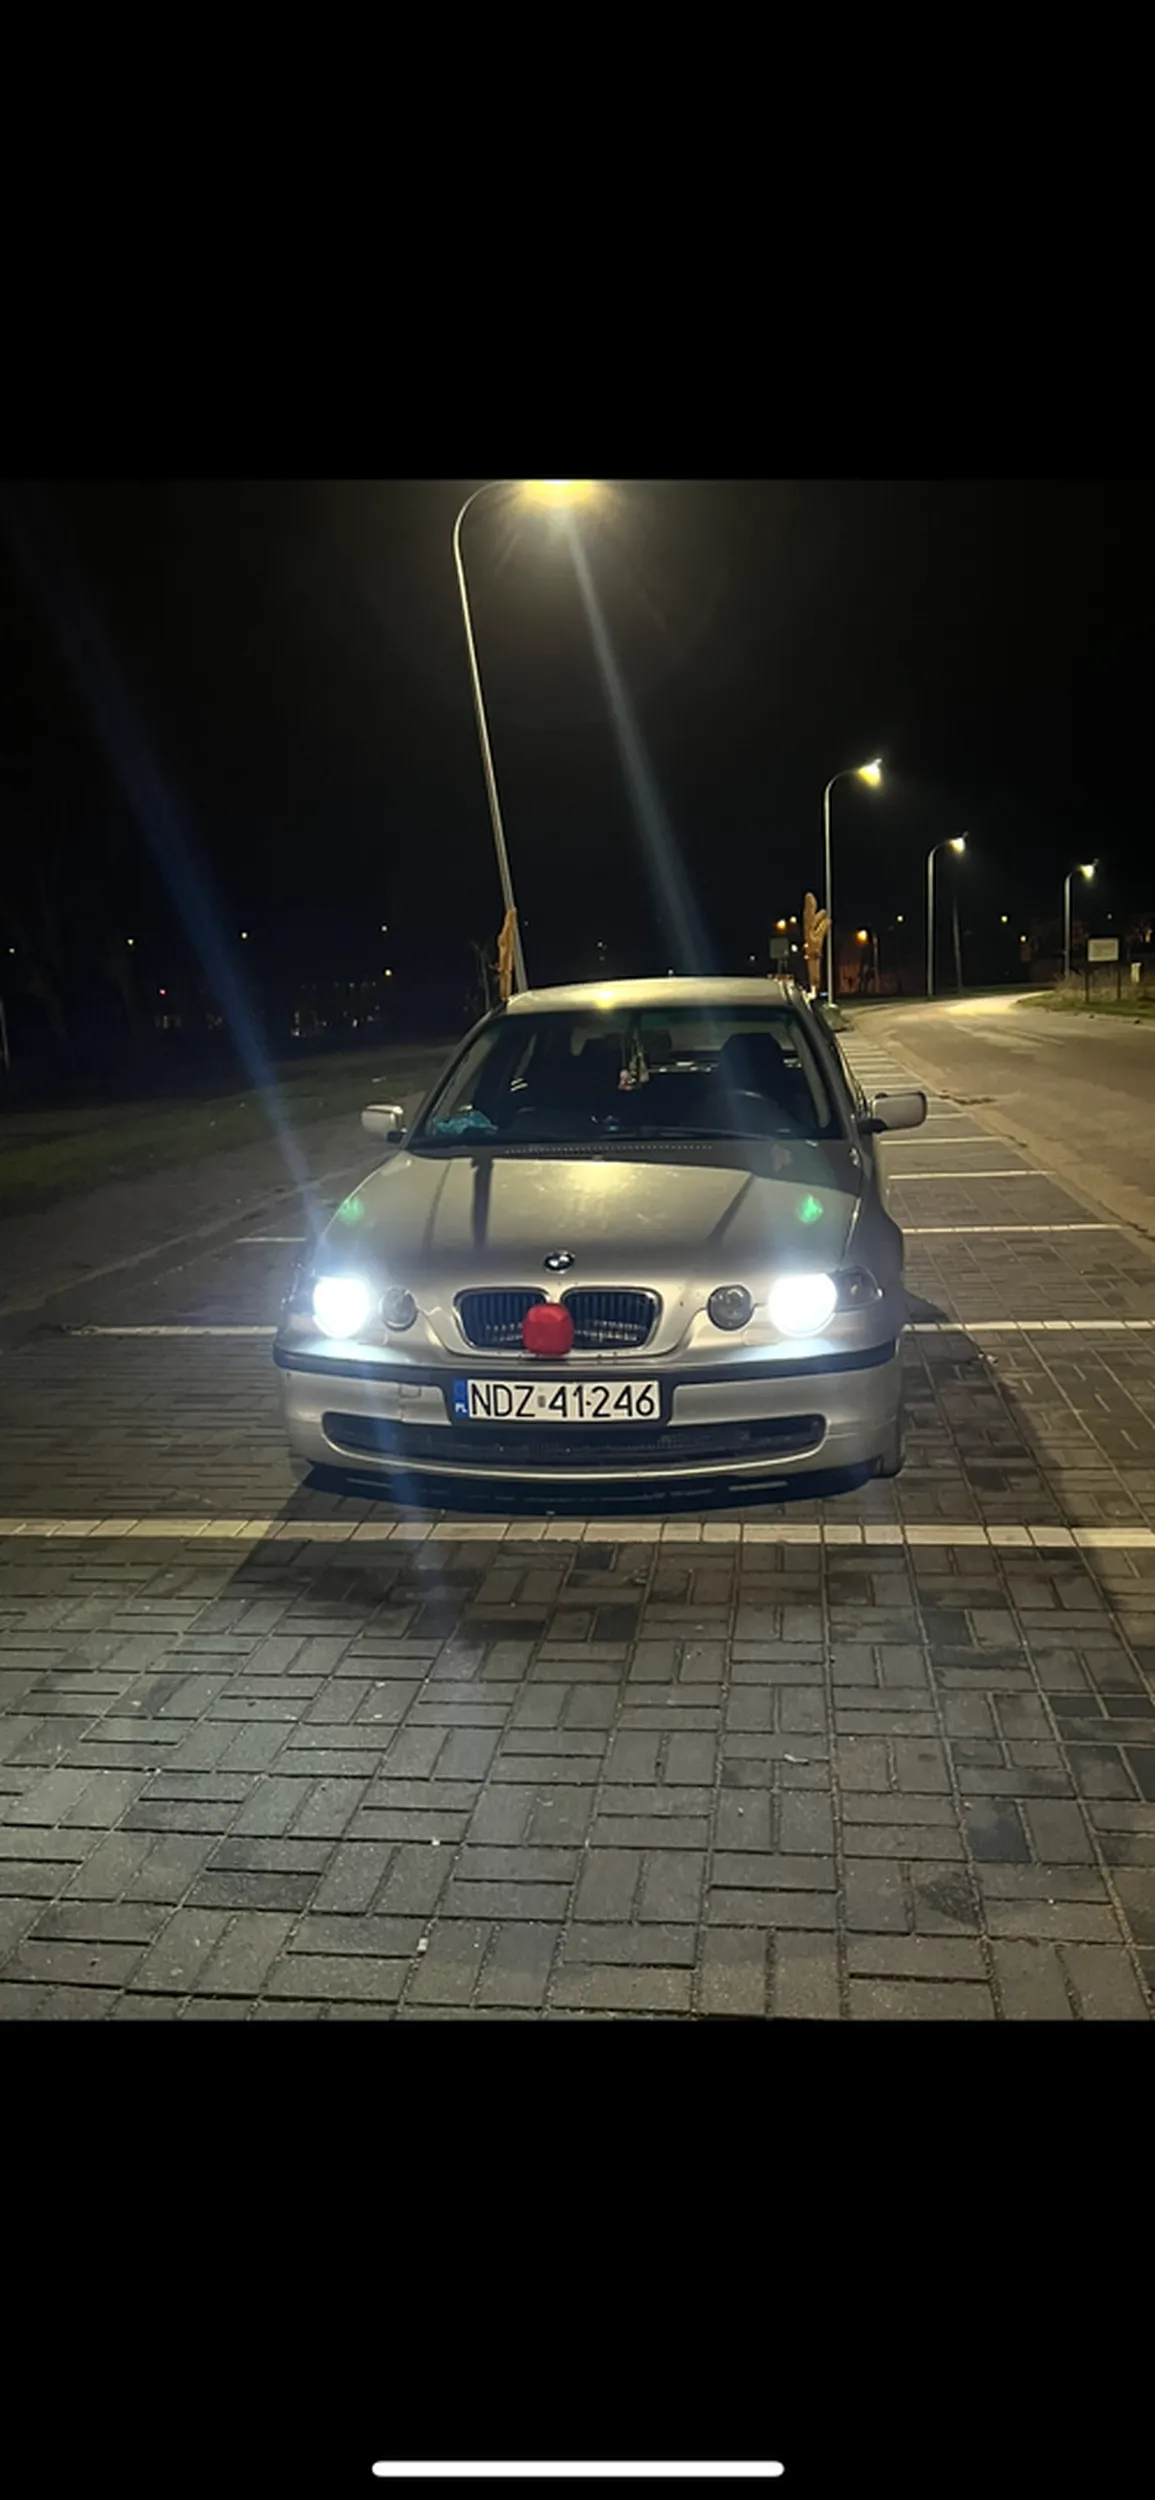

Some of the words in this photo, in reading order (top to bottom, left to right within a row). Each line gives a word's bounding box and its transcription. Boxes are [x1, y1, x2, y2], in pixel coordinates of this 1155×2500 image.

[455, 1403, 467, 1413] PL
[470, 1383, 536, 1417] NDZ
[548, 1384, 655, 1418] 41246
